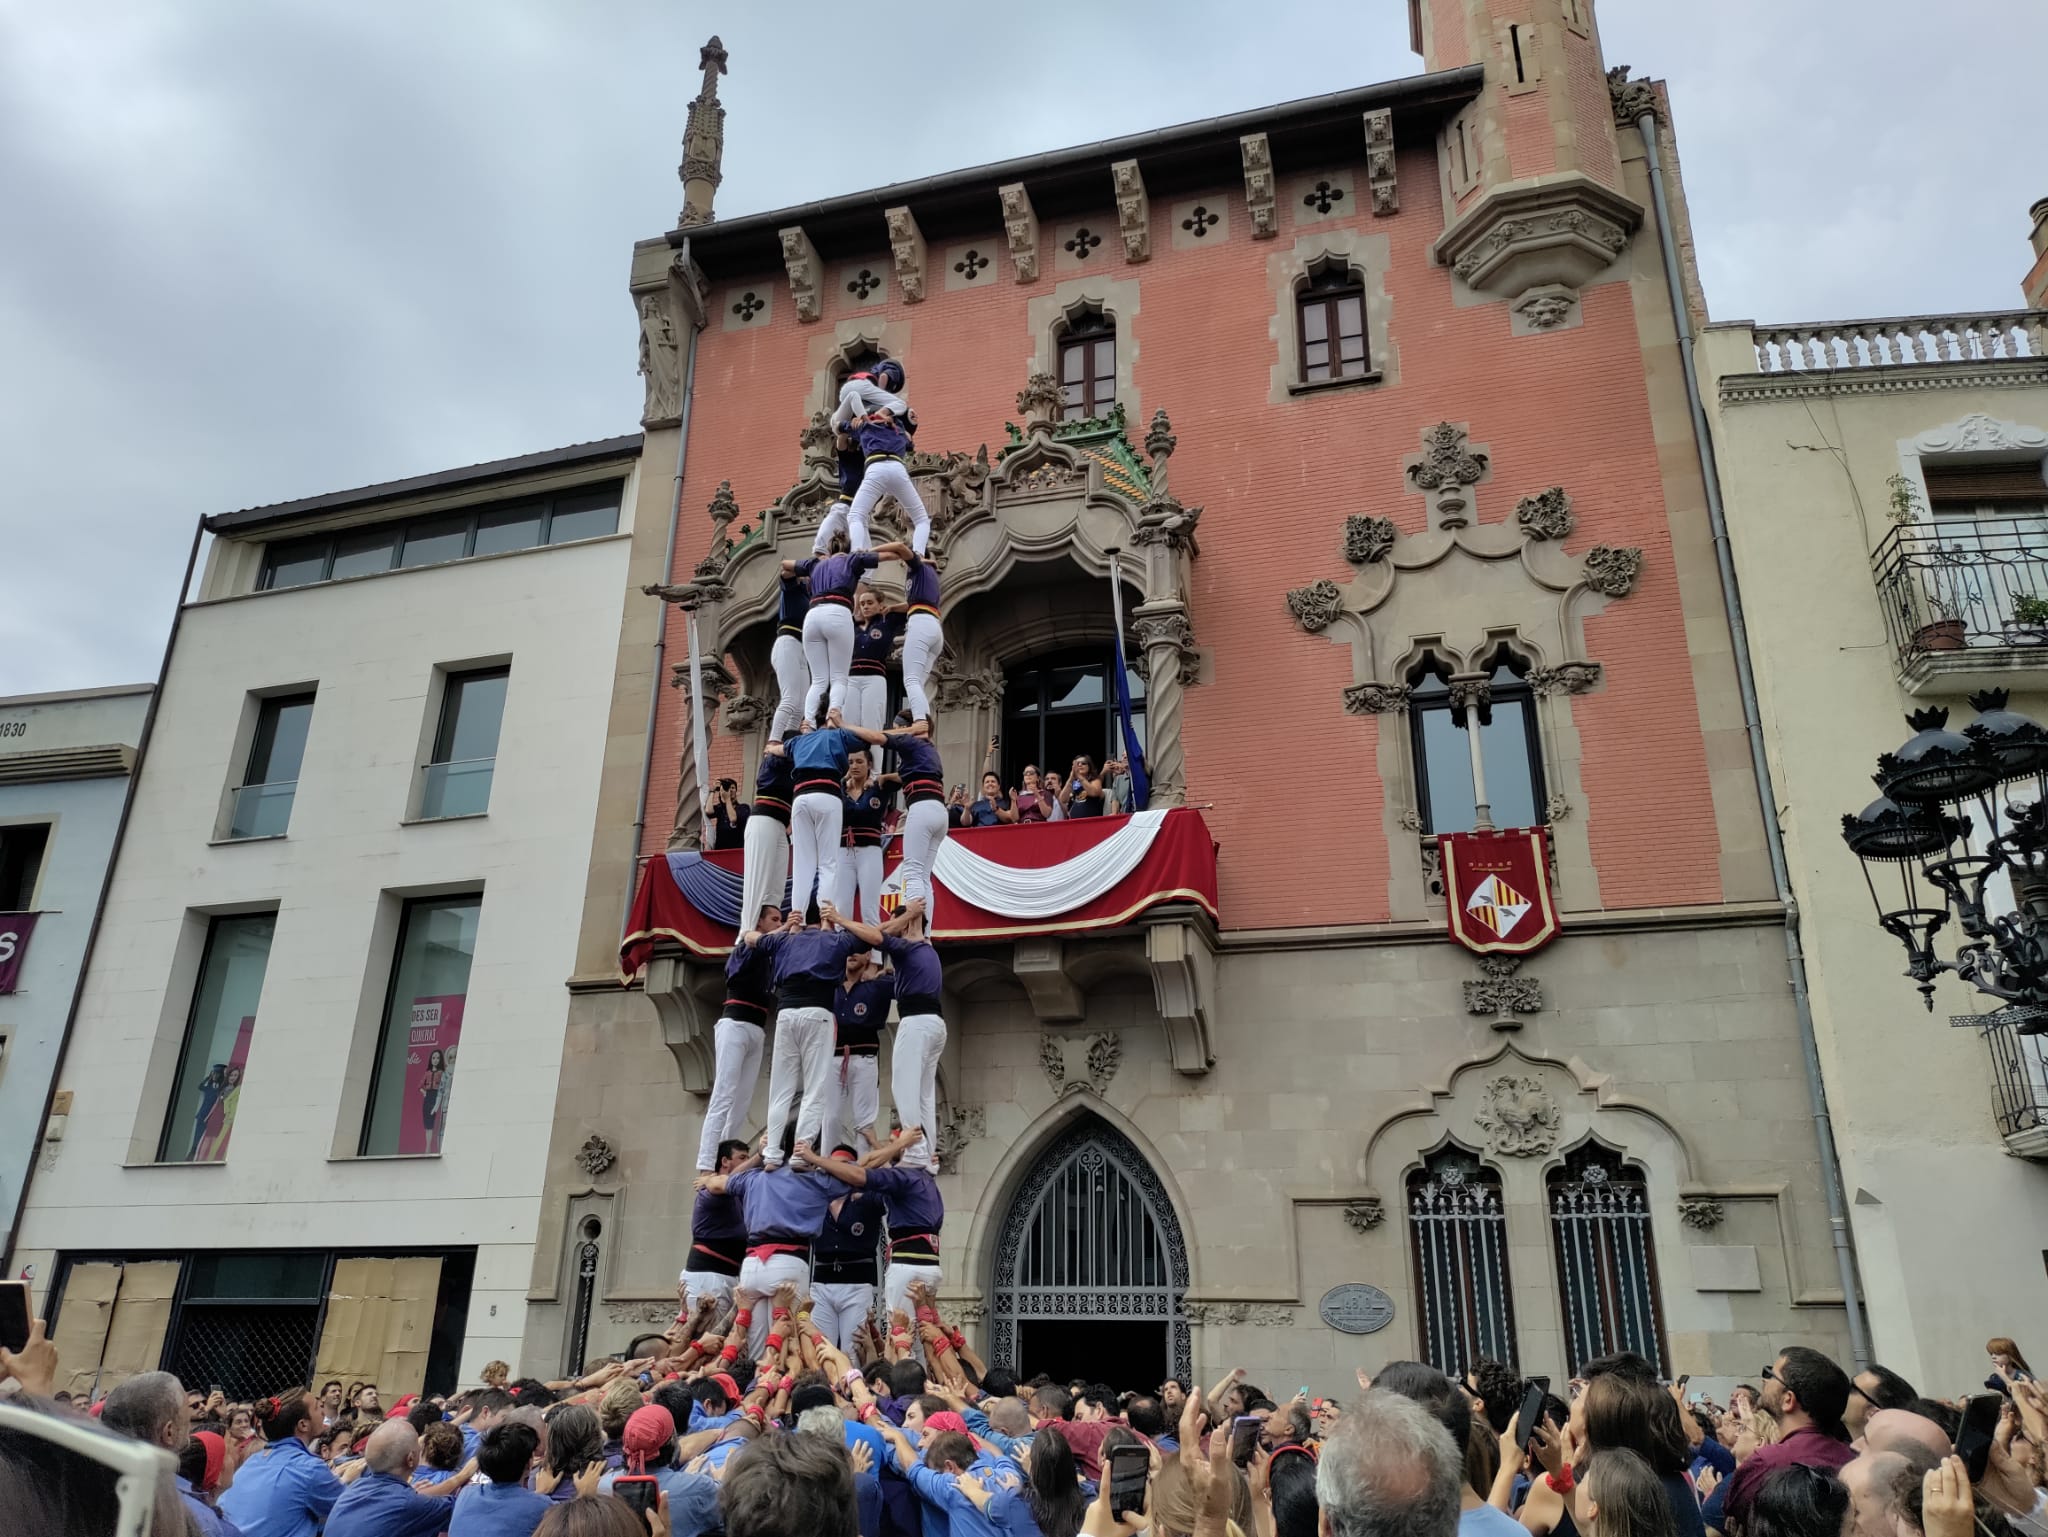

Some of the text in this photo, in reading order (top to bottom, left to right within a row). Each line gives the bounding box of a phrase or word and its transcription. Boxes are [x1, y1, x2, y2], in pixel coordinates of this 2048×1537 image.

[0, 722, 26, 737] 1830
[425, 1008, 438, 1021] SER
[490, 1305, 497, 1317] 5
